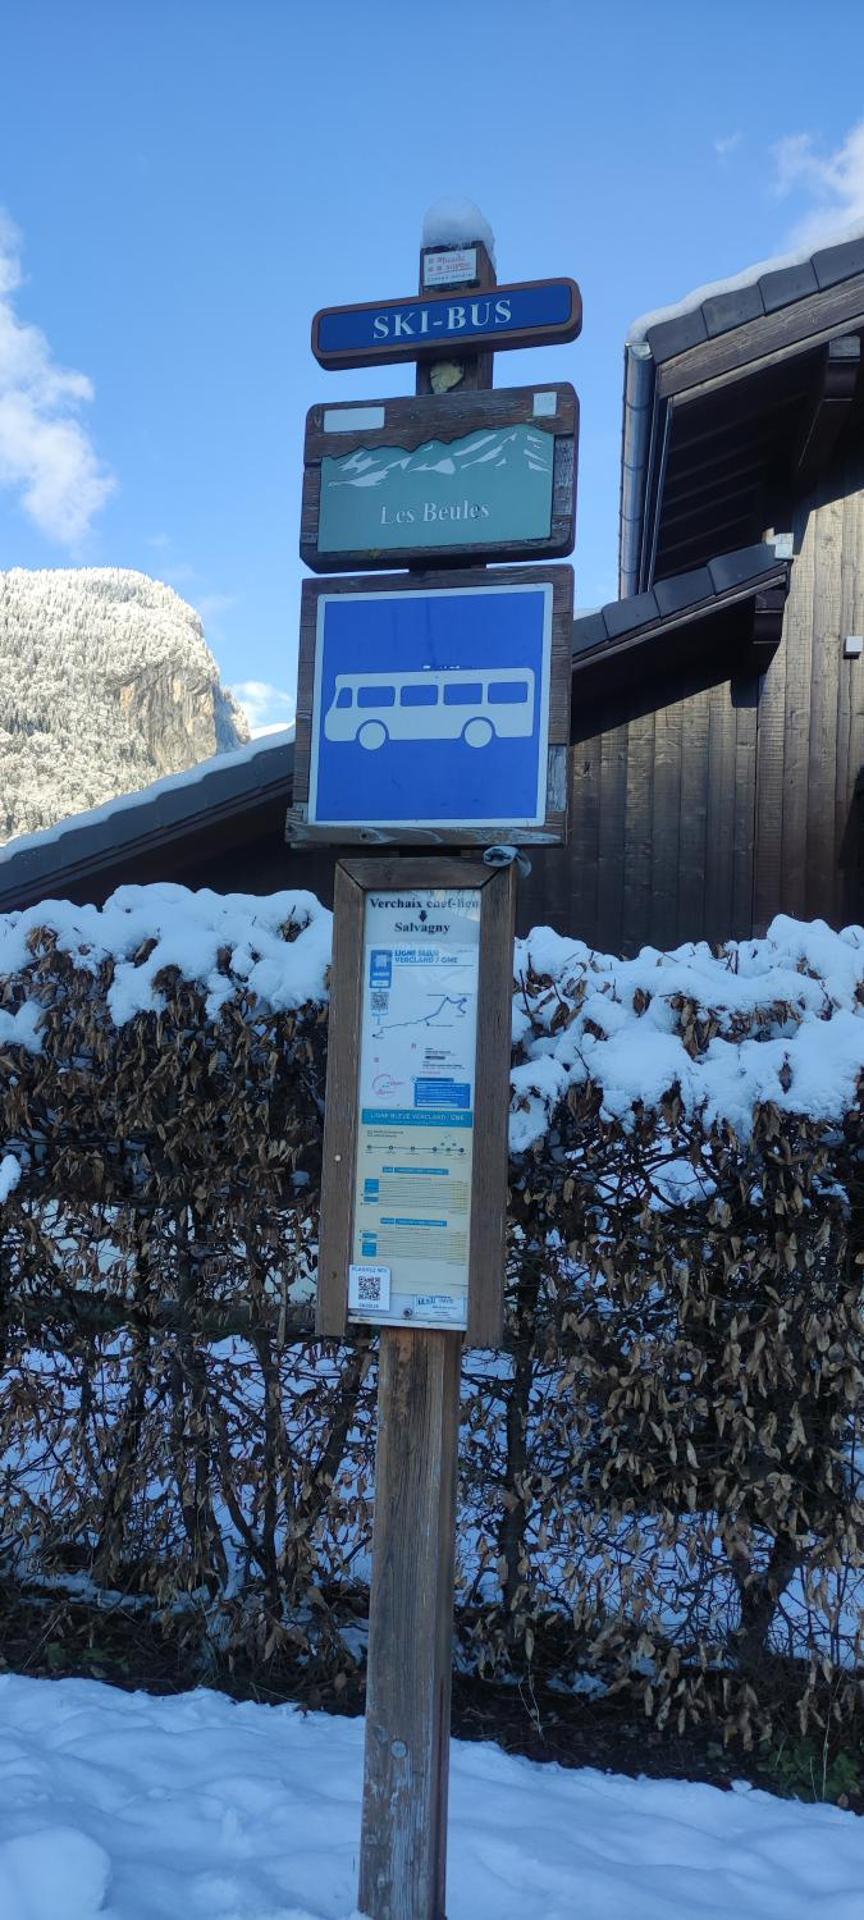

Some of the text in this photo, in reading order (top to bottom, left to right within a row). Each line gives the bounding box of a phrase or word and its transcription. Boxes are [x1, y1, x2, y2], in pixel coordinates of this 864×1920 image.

[373, 299, 512, 339] SKI-BUS
[380, 500, 489, 525] Les Beules
[370, 898, 422, 909] Verchaix
[394, 922, 451, 934] Salvagny
